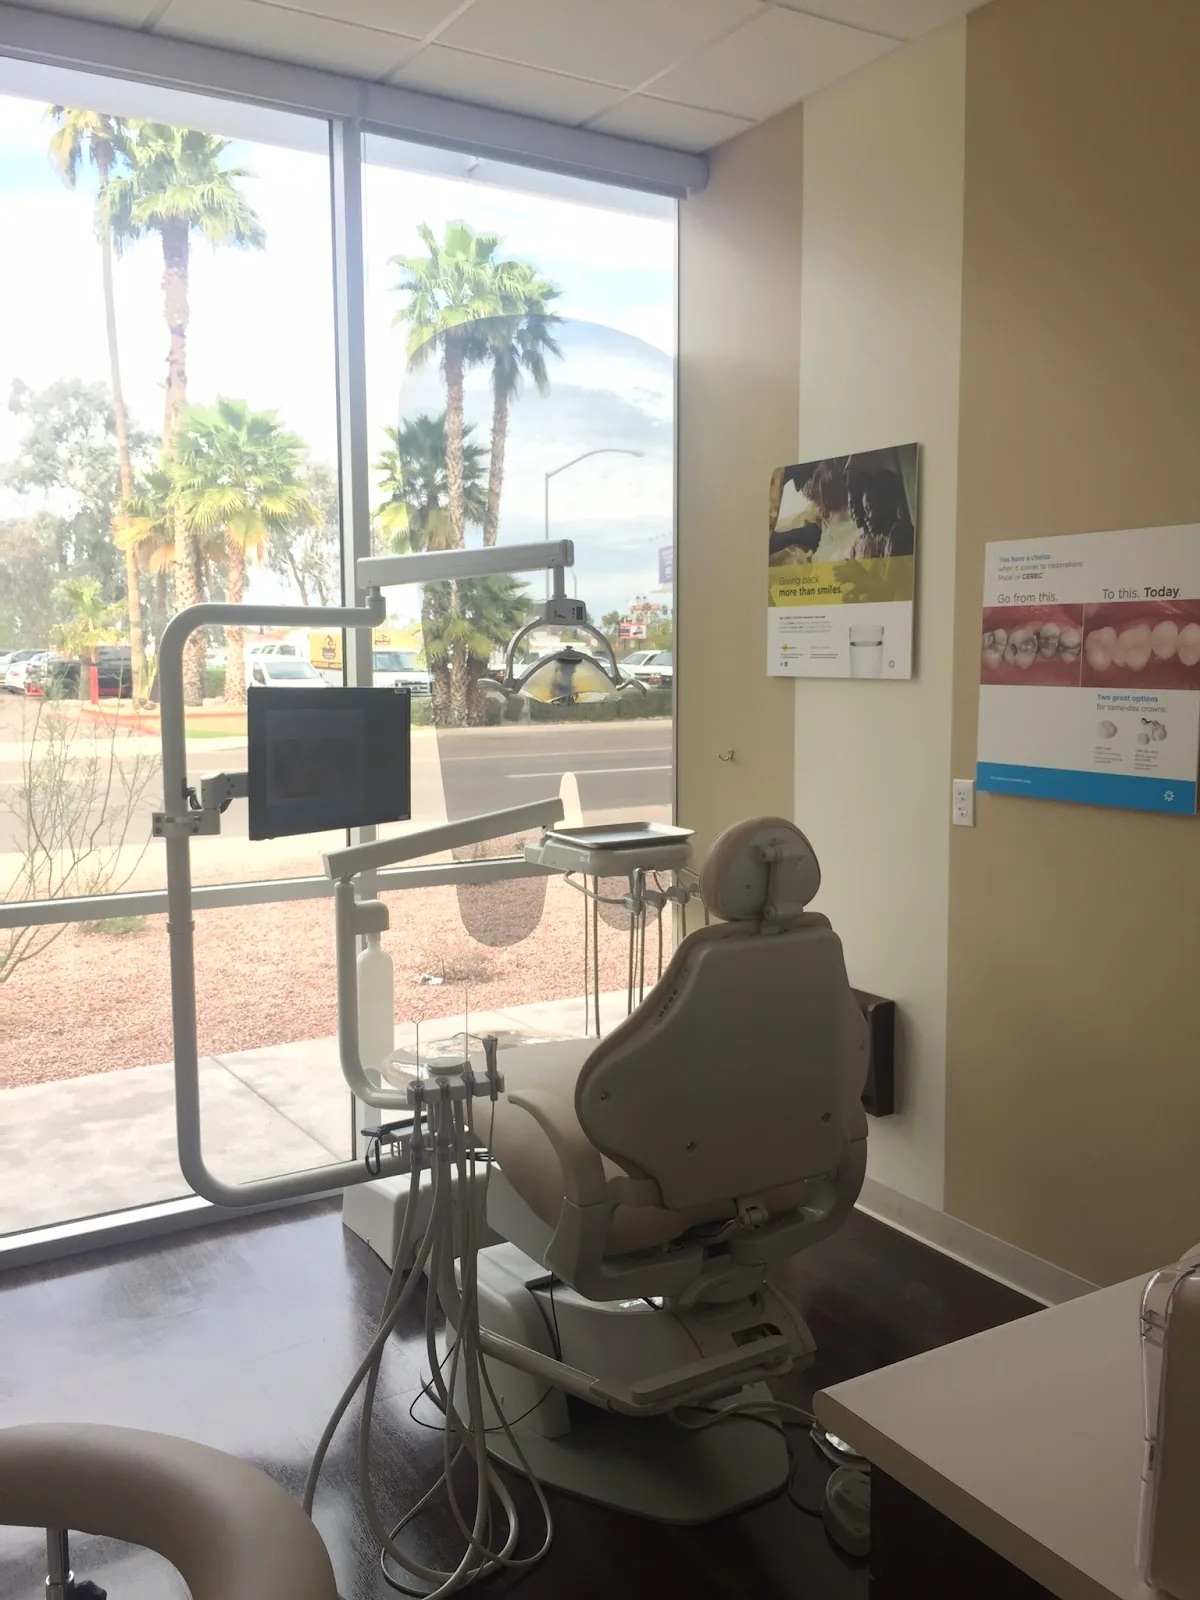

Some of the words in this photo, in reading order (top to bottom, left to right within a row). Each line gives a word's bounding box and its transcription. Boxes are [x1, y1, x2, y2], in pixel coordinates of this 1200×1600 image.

[779, 576, 801, 587] Giving
[802, 576, 820, 585] back
[778, 589, 798, 597] more
[799, 587, 816, 596] than
[817, 585, 844, 595] smiles.
[1102, 588, 1115, 600] To
[1118, 587, 1140, 599] this.
[997, 594, 1011, 604] Go
[1013, 592, 1036, 604] from
[1038, 592, 1058, 602] this.
[1131, 695, 1159, 703] options
[1107, 704, 1140, 712] same-day
